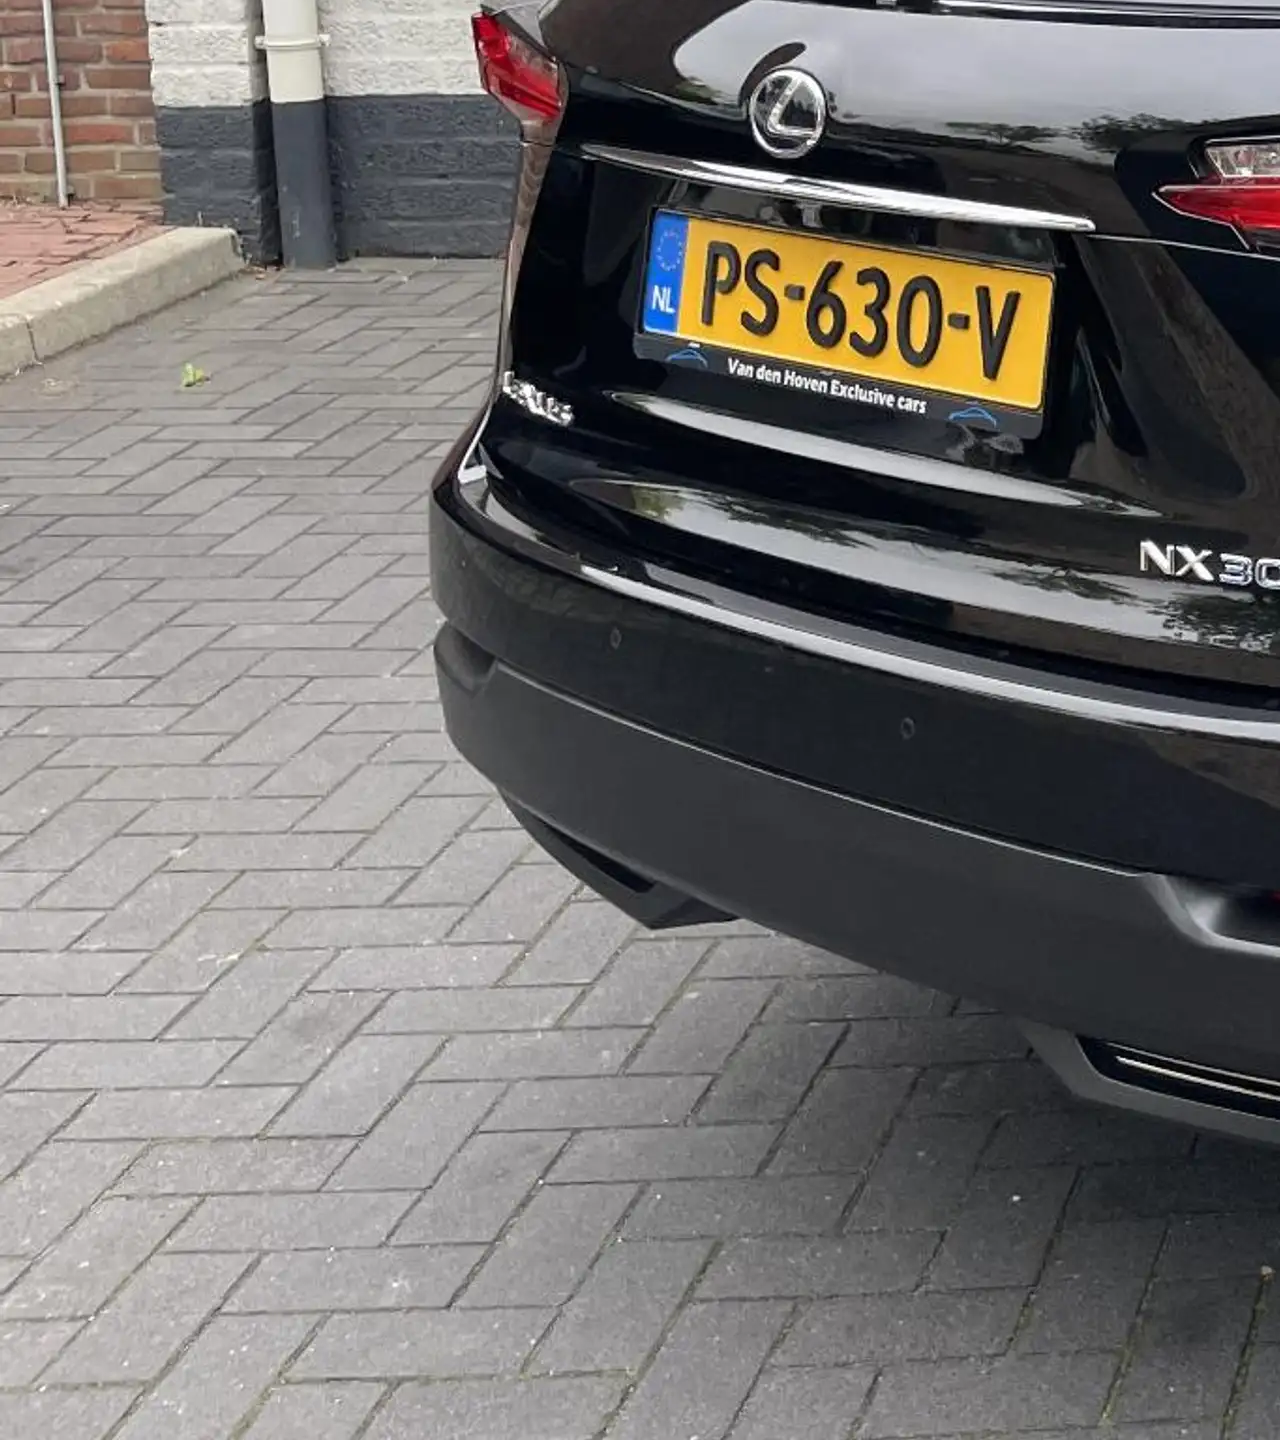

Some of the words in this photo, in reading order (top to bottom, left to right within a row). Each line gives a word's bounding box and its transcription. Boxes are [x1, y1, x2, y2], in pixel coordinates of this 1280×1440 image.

[651, 285, 675, 314] NL
[702, 240, 1021, 381] PS-630-V
[728, 358, 753, 380] Van
[756, 363, 781, 384] den
[783, 369, 828, 394] Hoven
[830, 379, 895, 409] Exclusive
[898, 393, 926, 414] cars
